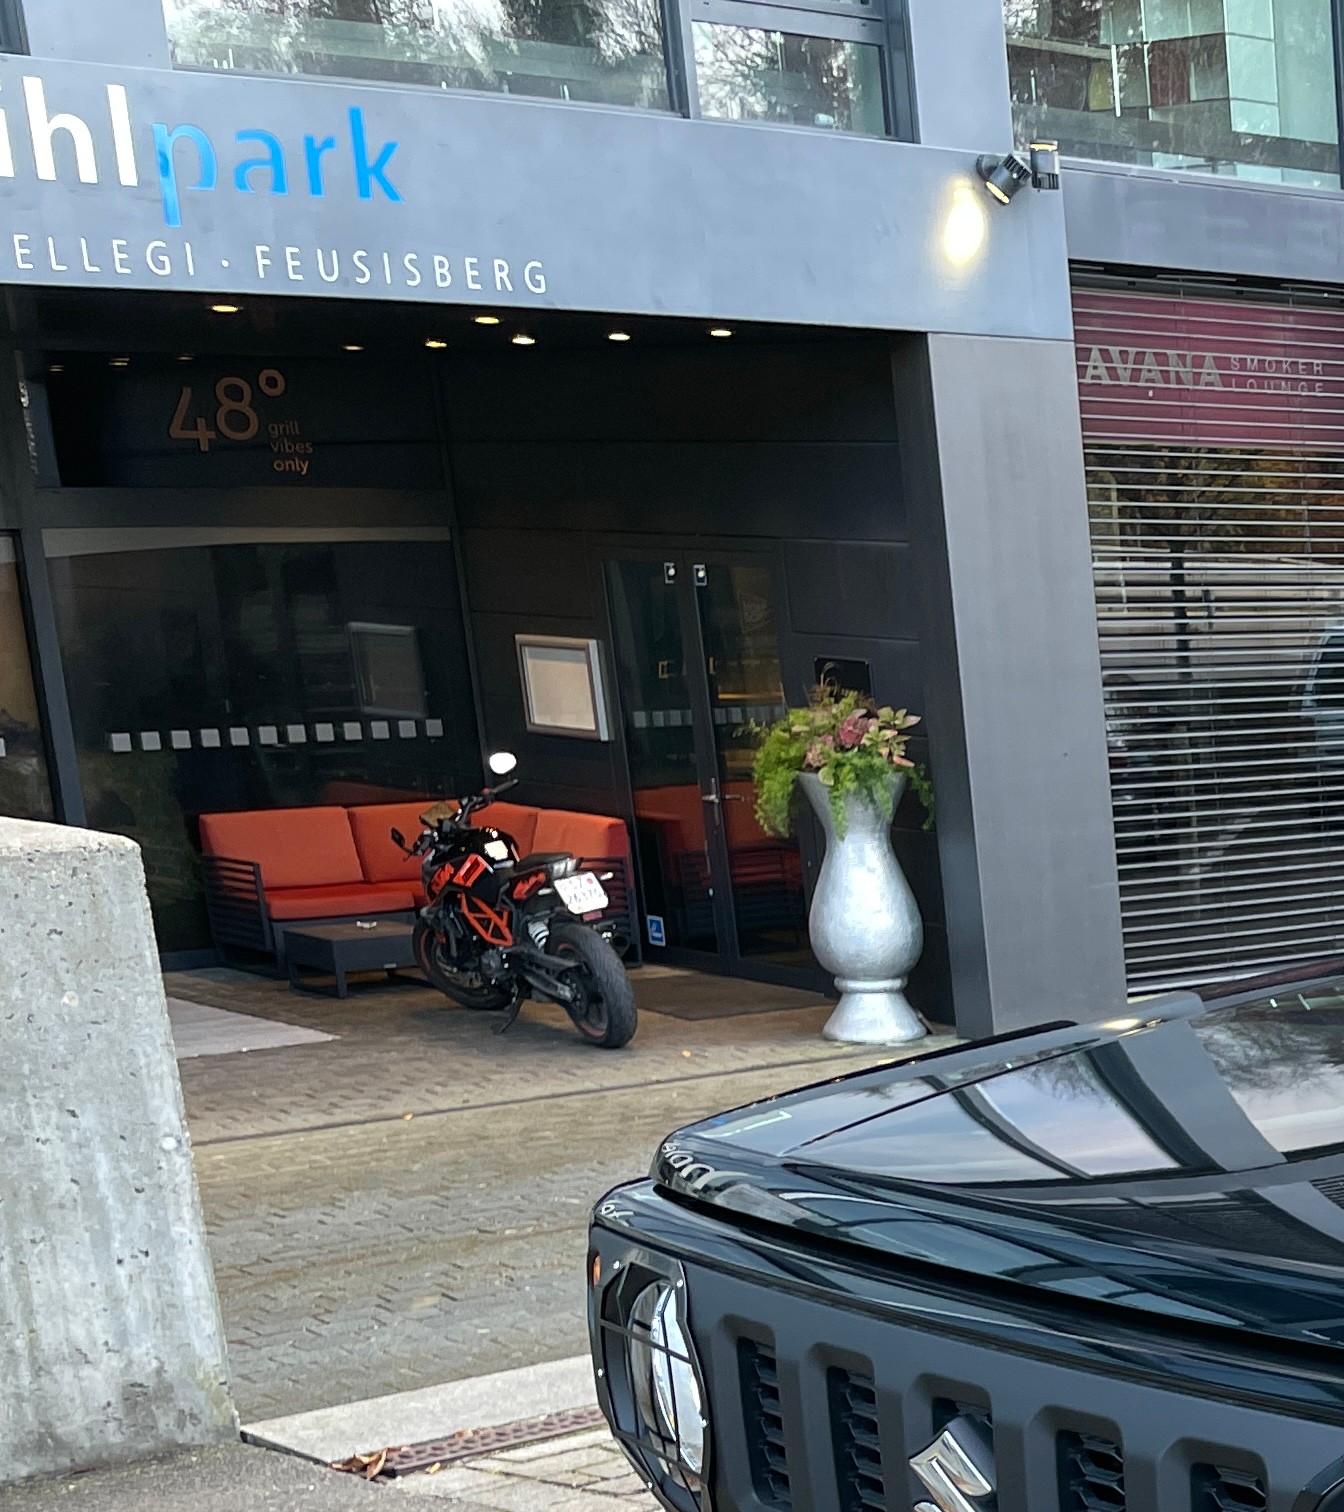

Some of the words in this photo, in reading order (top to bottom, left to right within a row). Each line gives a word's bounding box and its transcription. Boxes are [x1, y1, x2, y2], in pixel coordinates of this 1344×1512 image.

[255, 244, 548, 295] FEUSISBERG
[1230, 355, 1324, 376] SMOKER
[1231, 378, 1324, 395] LOUNGE
[268, 420, 300, 439] grill
[270, 439, 313, 454] vibes
[273, 458, 310, 476] only
